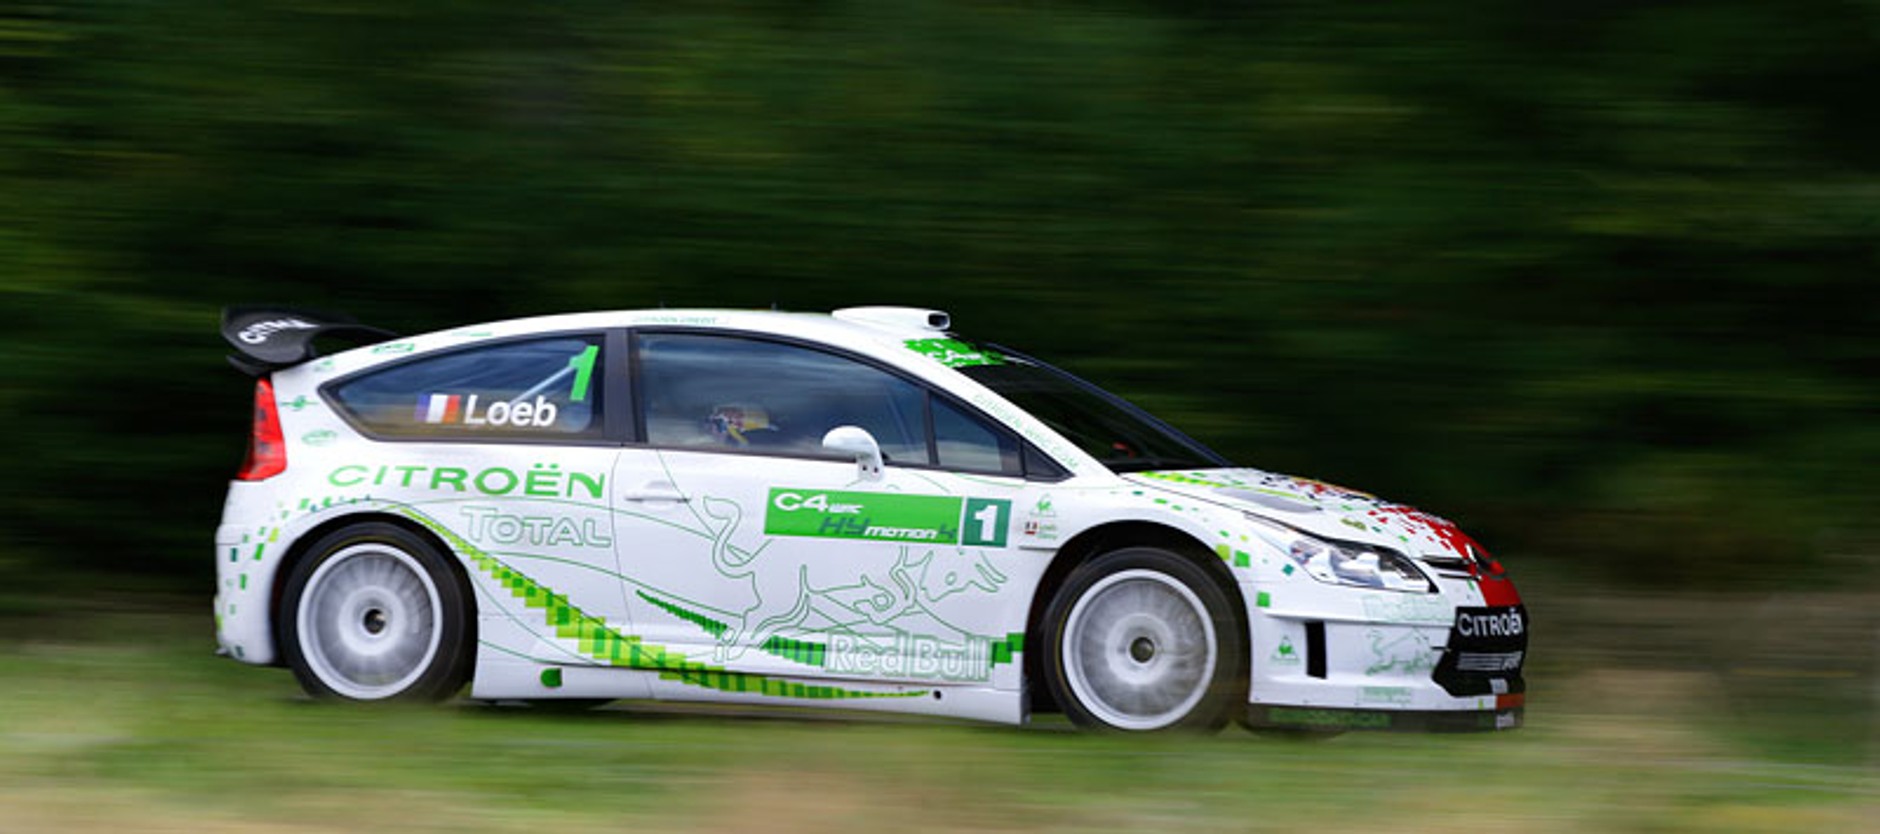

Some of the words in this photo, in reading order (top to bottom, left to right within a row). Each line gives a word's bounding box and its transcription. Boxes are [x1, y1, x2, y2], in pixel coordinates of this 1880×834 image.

[569, 345, 599, 401] 1
[464, 394, 557, 427] Loeb
[327, 463, 605, 498] CITROËN
[774, 493, 828, 512] C4
[974, 504, 999, 542] 1
[827, 631, 909, 676] Red
[911, 635, 990, 681] Bull
